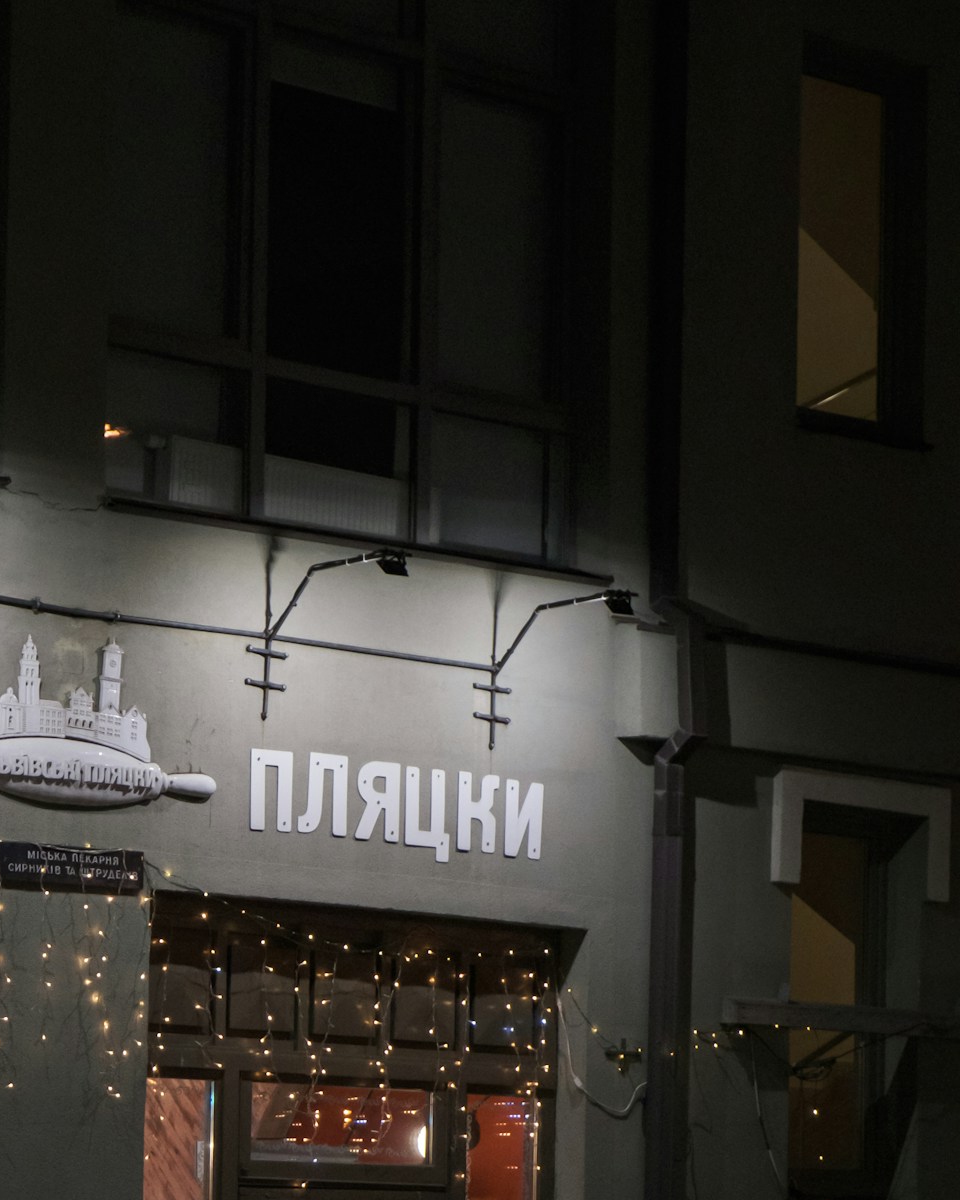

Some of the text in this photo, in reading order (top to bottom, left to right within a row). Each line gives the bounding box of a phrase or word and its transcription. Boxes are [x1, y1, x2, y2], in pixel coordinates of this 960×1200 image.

[250, 748, 545, 863] ПЛЯЦКИ
[27, 849, 120, 867] МІСЬКА ПЕКАРНЯ
[65, 865, 76, 876] ТА
